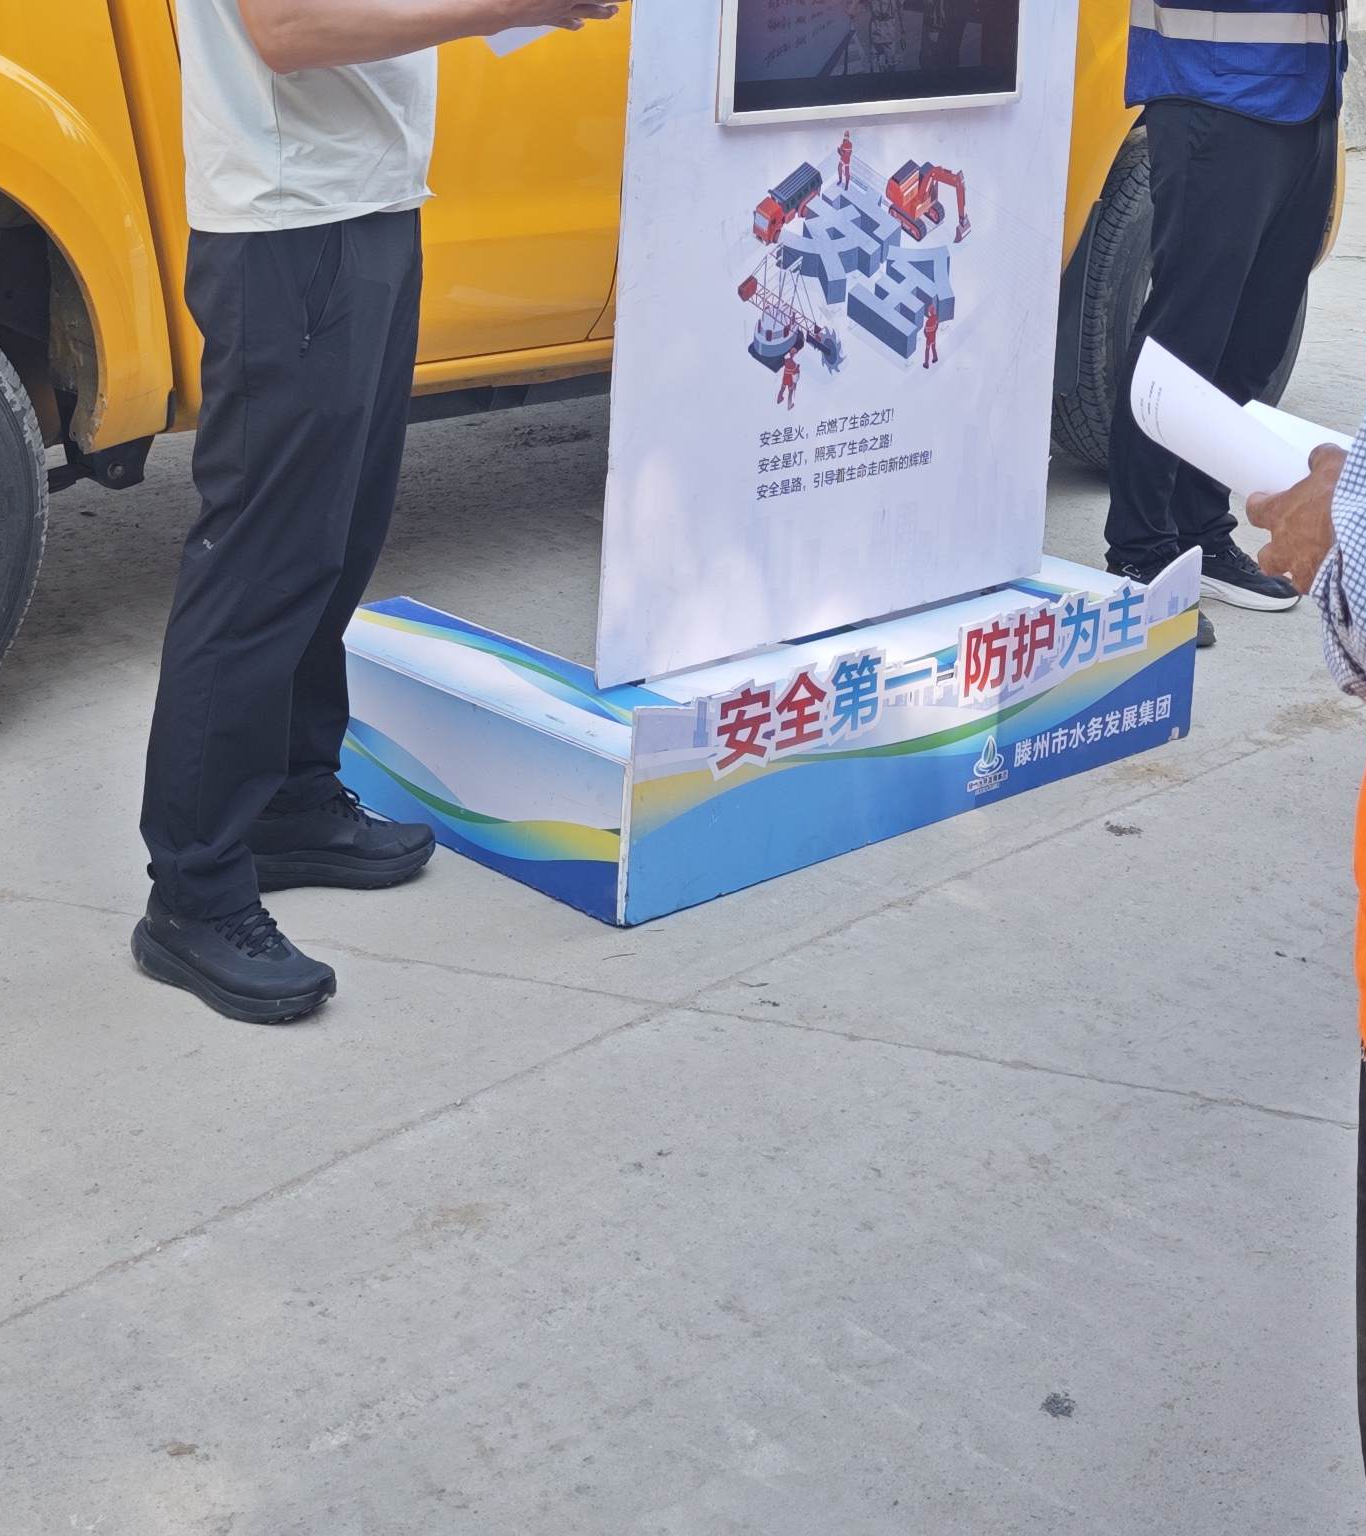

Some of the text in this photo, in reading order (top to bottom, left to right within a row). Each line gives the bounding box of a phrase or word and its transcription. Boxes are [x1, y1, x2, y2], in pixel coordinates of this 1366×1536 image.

[716, 586, 1145, 771] 安全第一 防护为主
[1013, 693, 1172, 768] 滕州市水务发展集团
